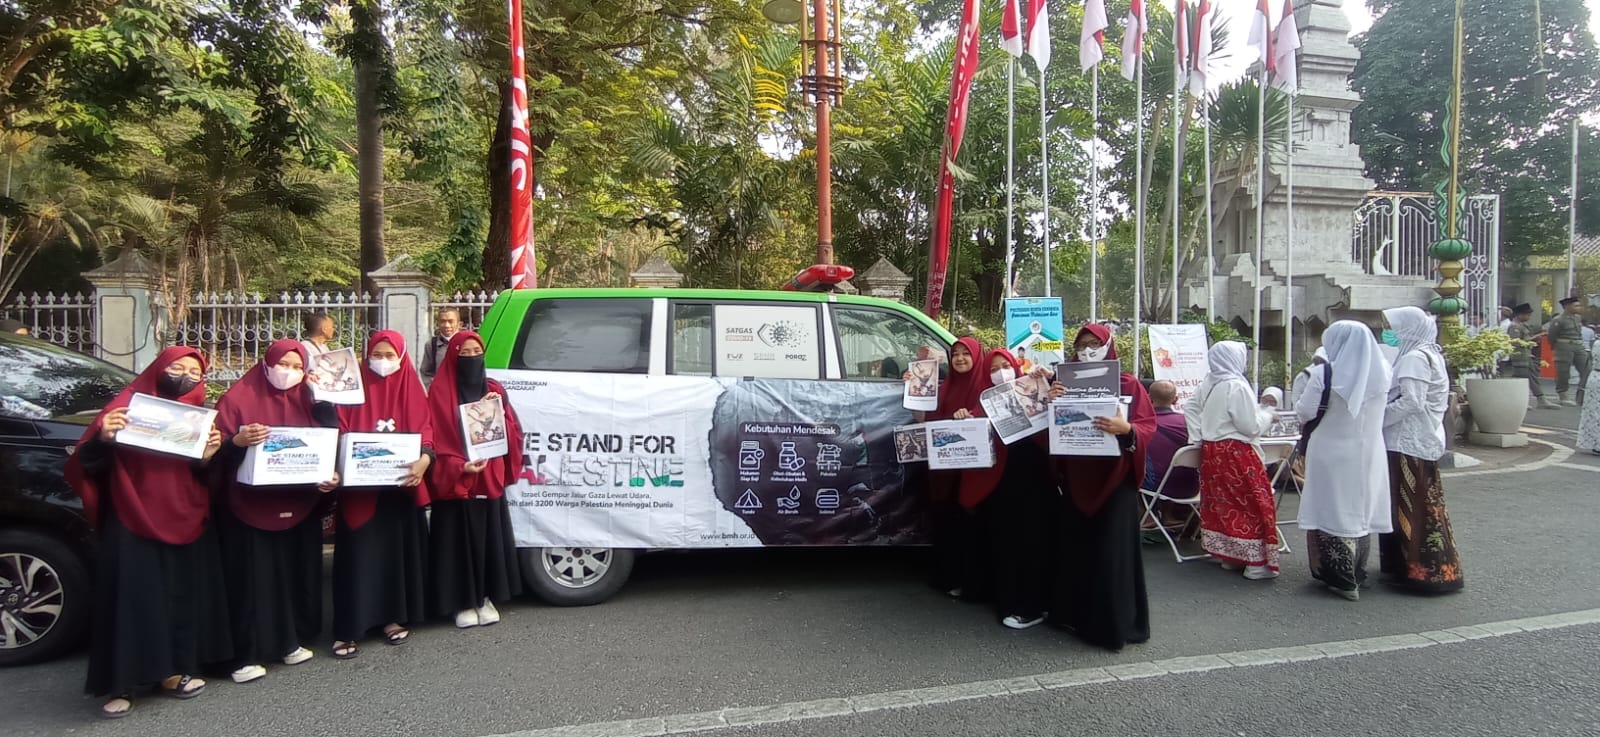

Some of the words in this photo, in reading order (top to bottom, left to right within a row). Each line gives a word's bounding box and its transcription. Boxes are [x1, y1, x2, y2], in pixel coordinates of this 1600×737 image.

[744, 424, 792, 434] Kebutuhan
[793, 425, 836, 435] Mendesak
[547, 433, 622, 453] STAND
[629, 434, 676, 454] FOR
[516, 454, 684, 487] ALESTINE
[541, 491, 570, 499] Gempur
[614, 501, 652, 509] Meninggal
